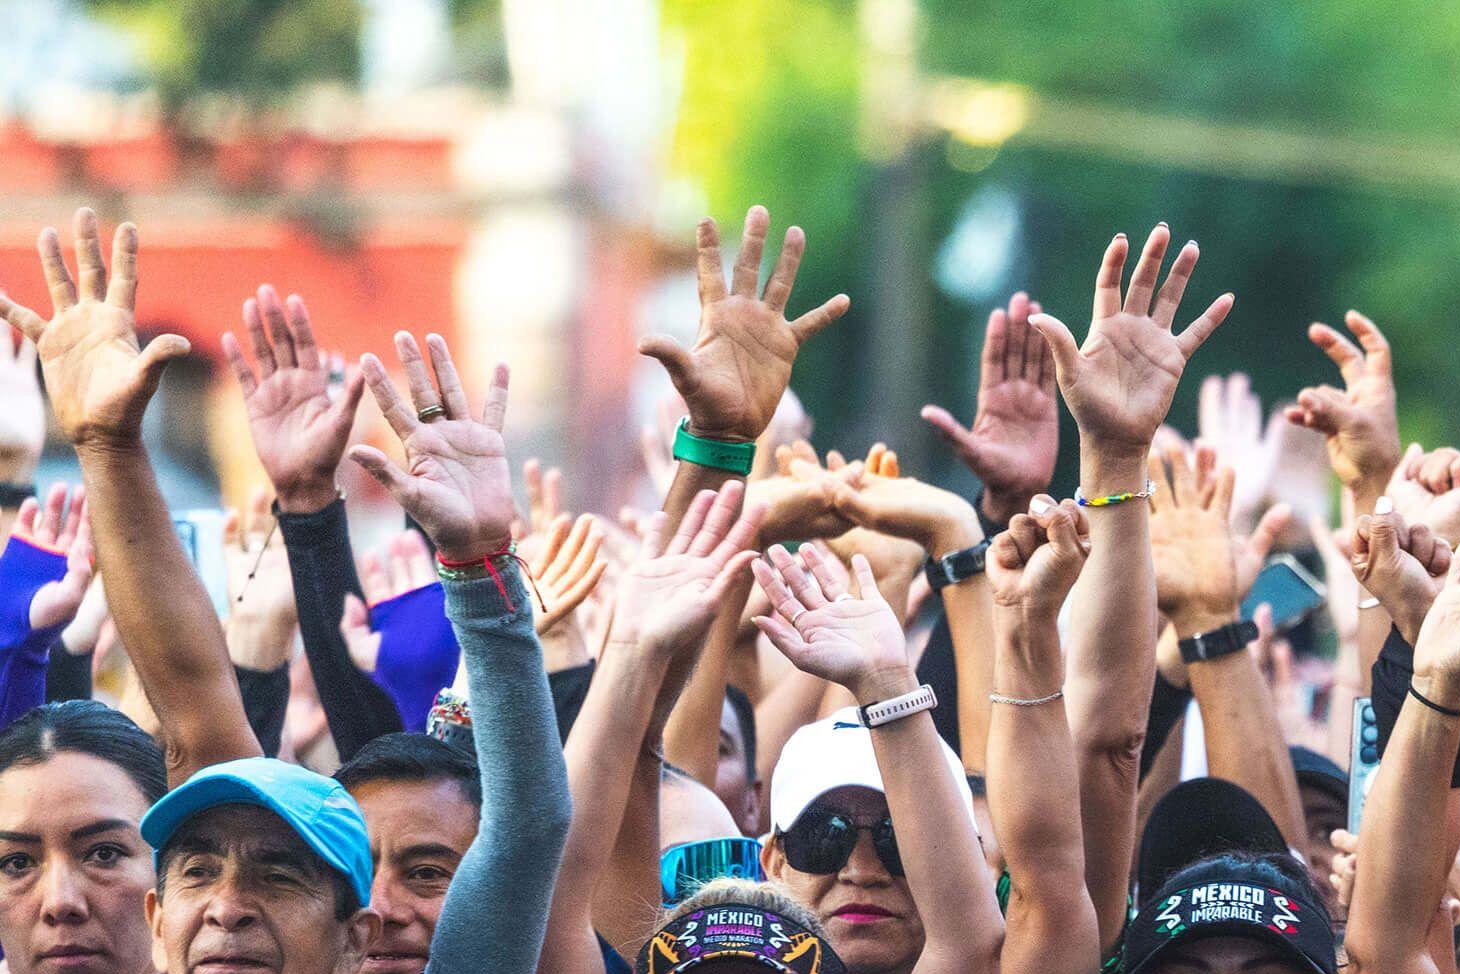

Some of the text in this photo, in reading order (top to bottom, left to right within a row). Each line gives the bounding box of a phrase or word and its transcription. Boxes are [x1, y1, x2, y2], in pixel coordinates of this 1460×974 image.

[1191, 883, 1265, 906] MÉXICO
[706, 909, 764, 928] MÉXICO
[1191, 906, 1263, 923] IMPARABLE
[705, 925, 763, 937] IMPARABLE
